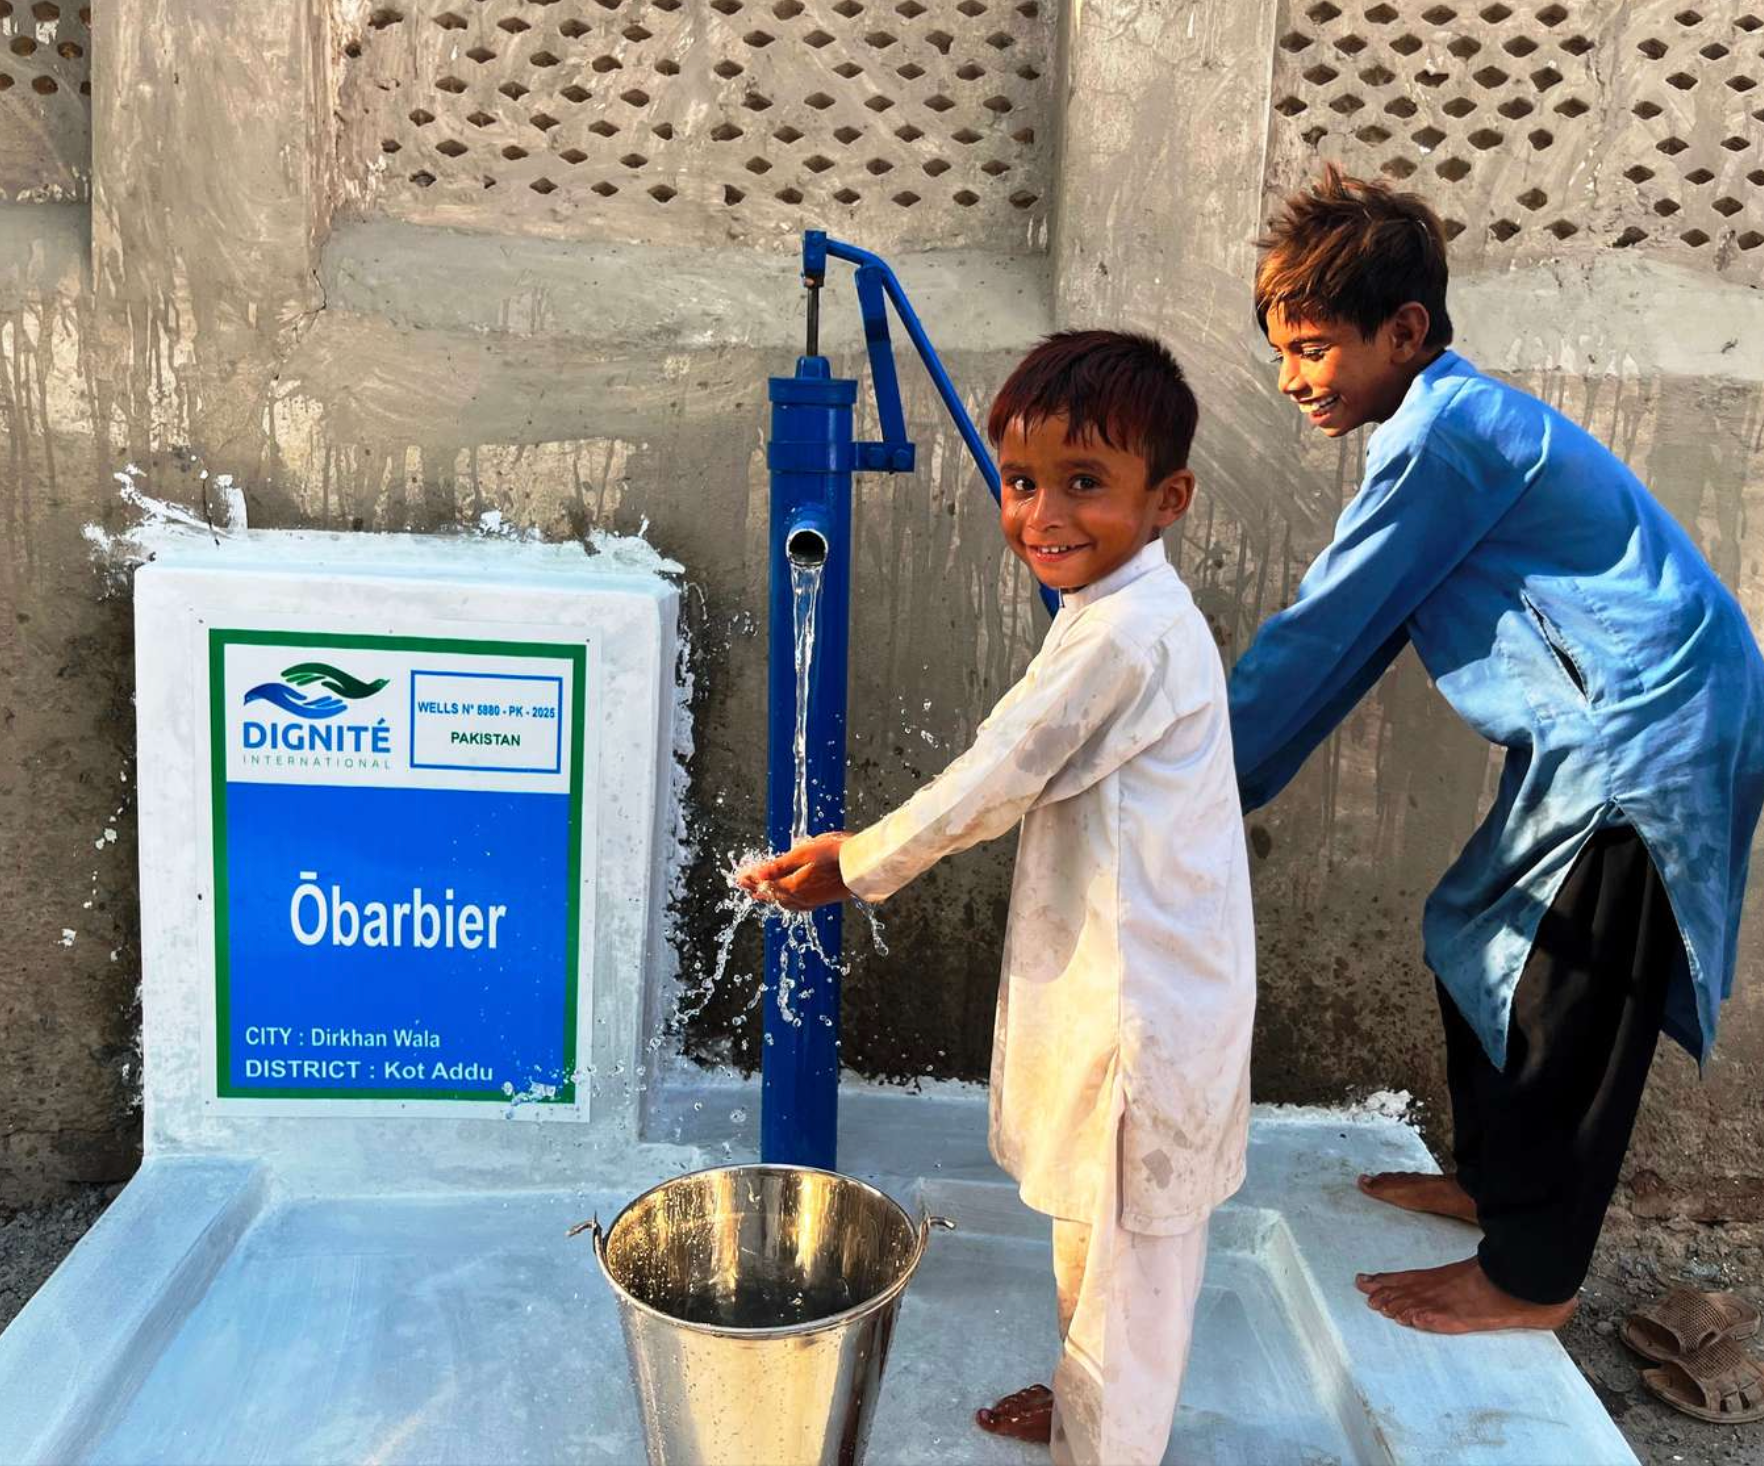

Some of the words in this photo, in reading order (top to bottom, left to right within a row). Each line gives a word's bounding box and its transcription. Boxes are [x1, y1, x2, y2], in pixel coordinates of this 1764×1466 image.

[418, 702, 459, 714] WELLS
[508, 705, 523, 717] PK
[532, 706, 555, 718] 2025
[243, 718, 391, 753] DIGNITÉ
[451, 732, 521, 746] PAKISTAN
[243, 755, 391, 769] INTERNATIONAL
[290, 871, 507, 949] Ōbarbier
[245, 1026, 292, 1045] CITY
[311, 1028, 387, 1047] Dirkhan
[393, 1029, 441, 1047] Wala
[245, 1059, 361, 1079] DISTRICT
[384, 1061, 425, 1079] Kot
[431, 1062, 493, 1080] Addu
